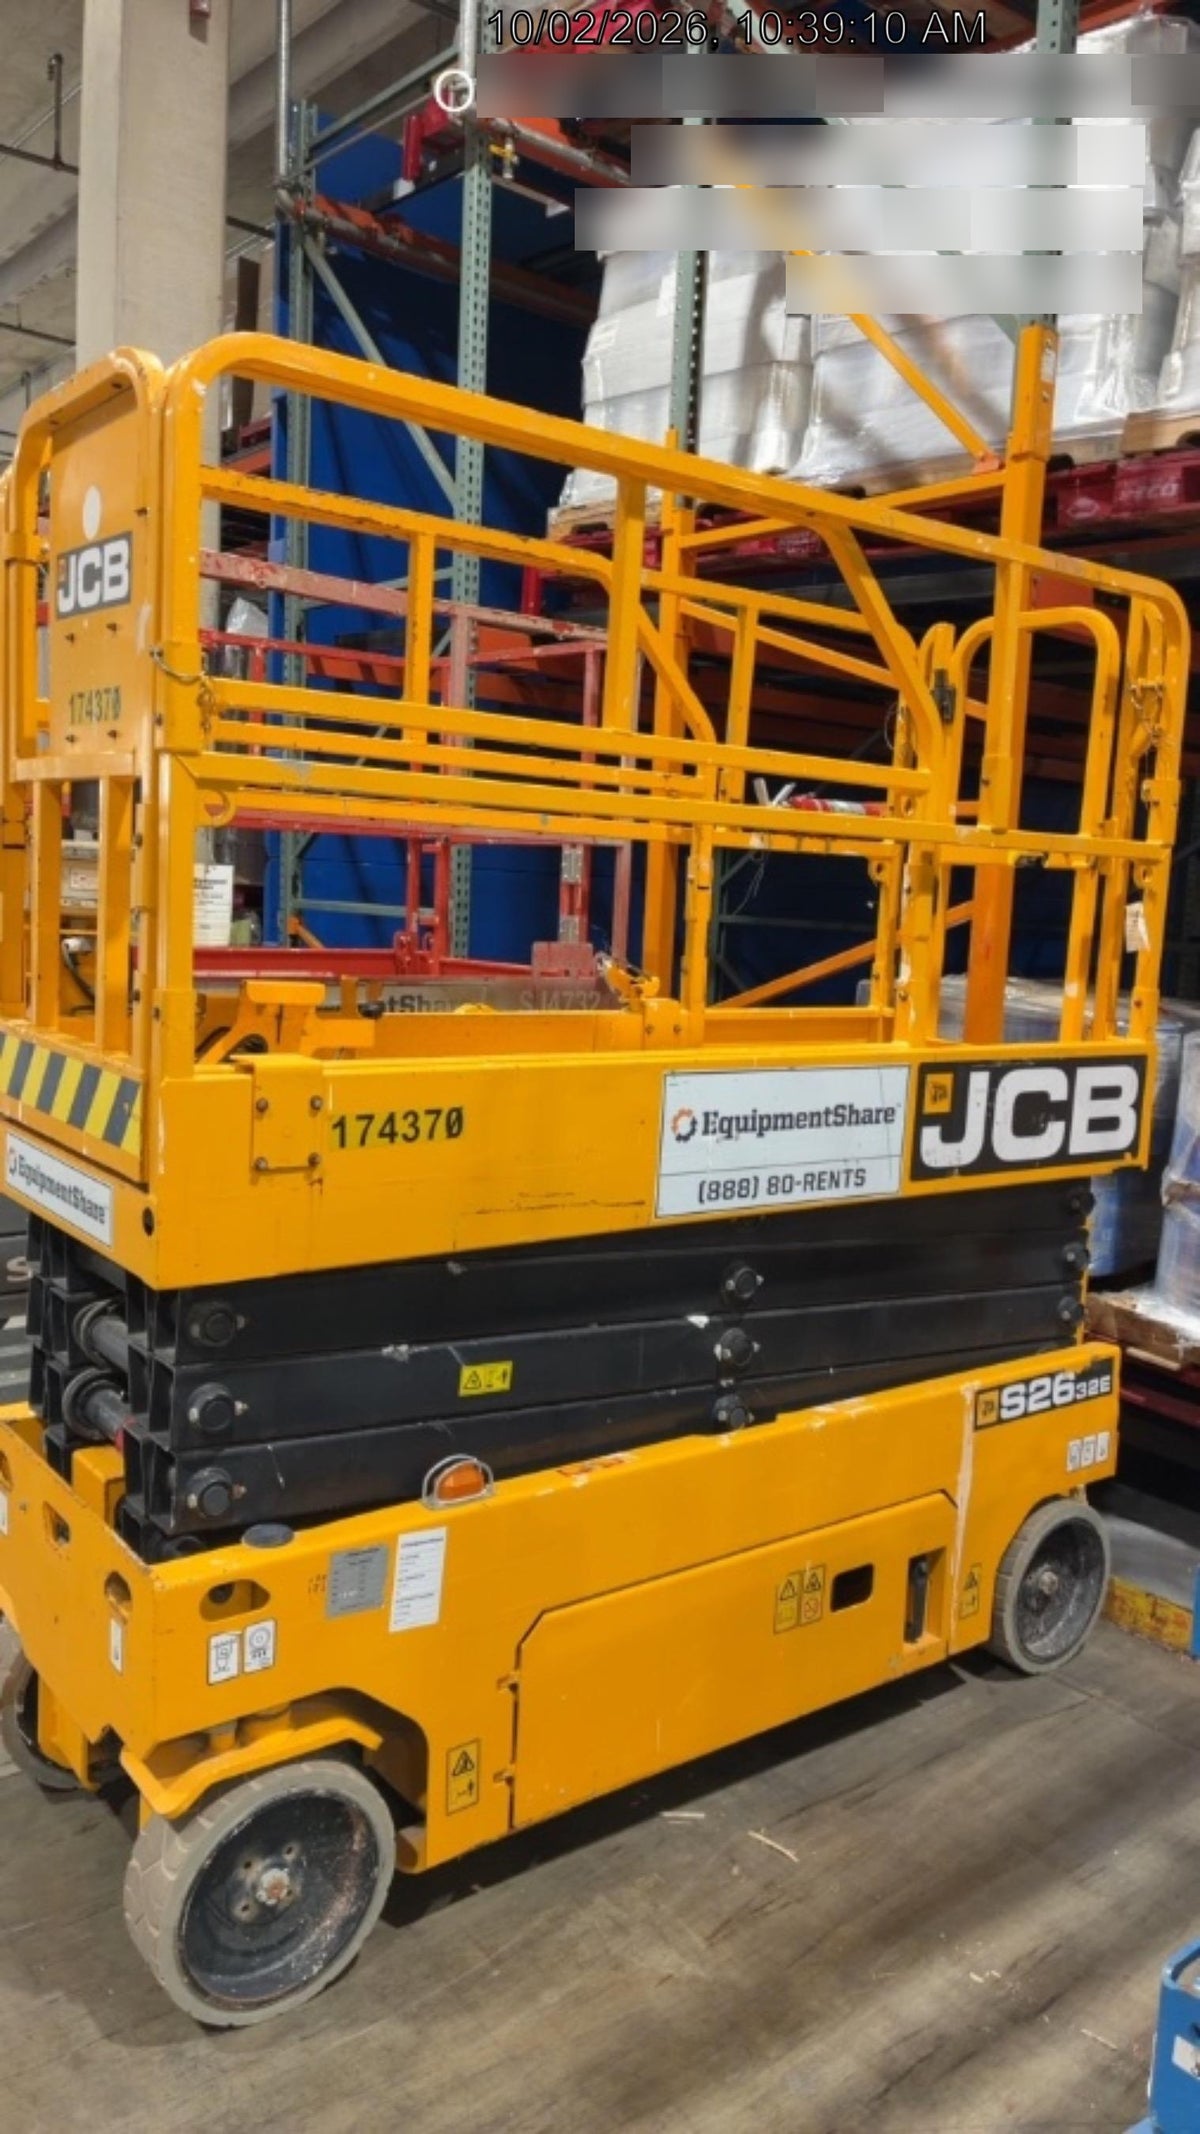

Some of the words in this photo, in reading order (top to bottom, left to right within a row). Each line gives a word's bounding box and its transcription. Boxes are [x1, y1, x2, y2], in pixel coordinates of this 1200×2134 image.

[57, 538, 130, 614] JCB
[331, 1106, 464, 1149] 174370
[701, 1103, 896, 1138] EquipmentShare
[920, 1064, 1139, 1169] JCB
[18, 1156, 106, 1224] EquipmentShare
[698, 1176, 760, 1204] (888)
[766, 1168, 867, 1196] 80-RENTS
